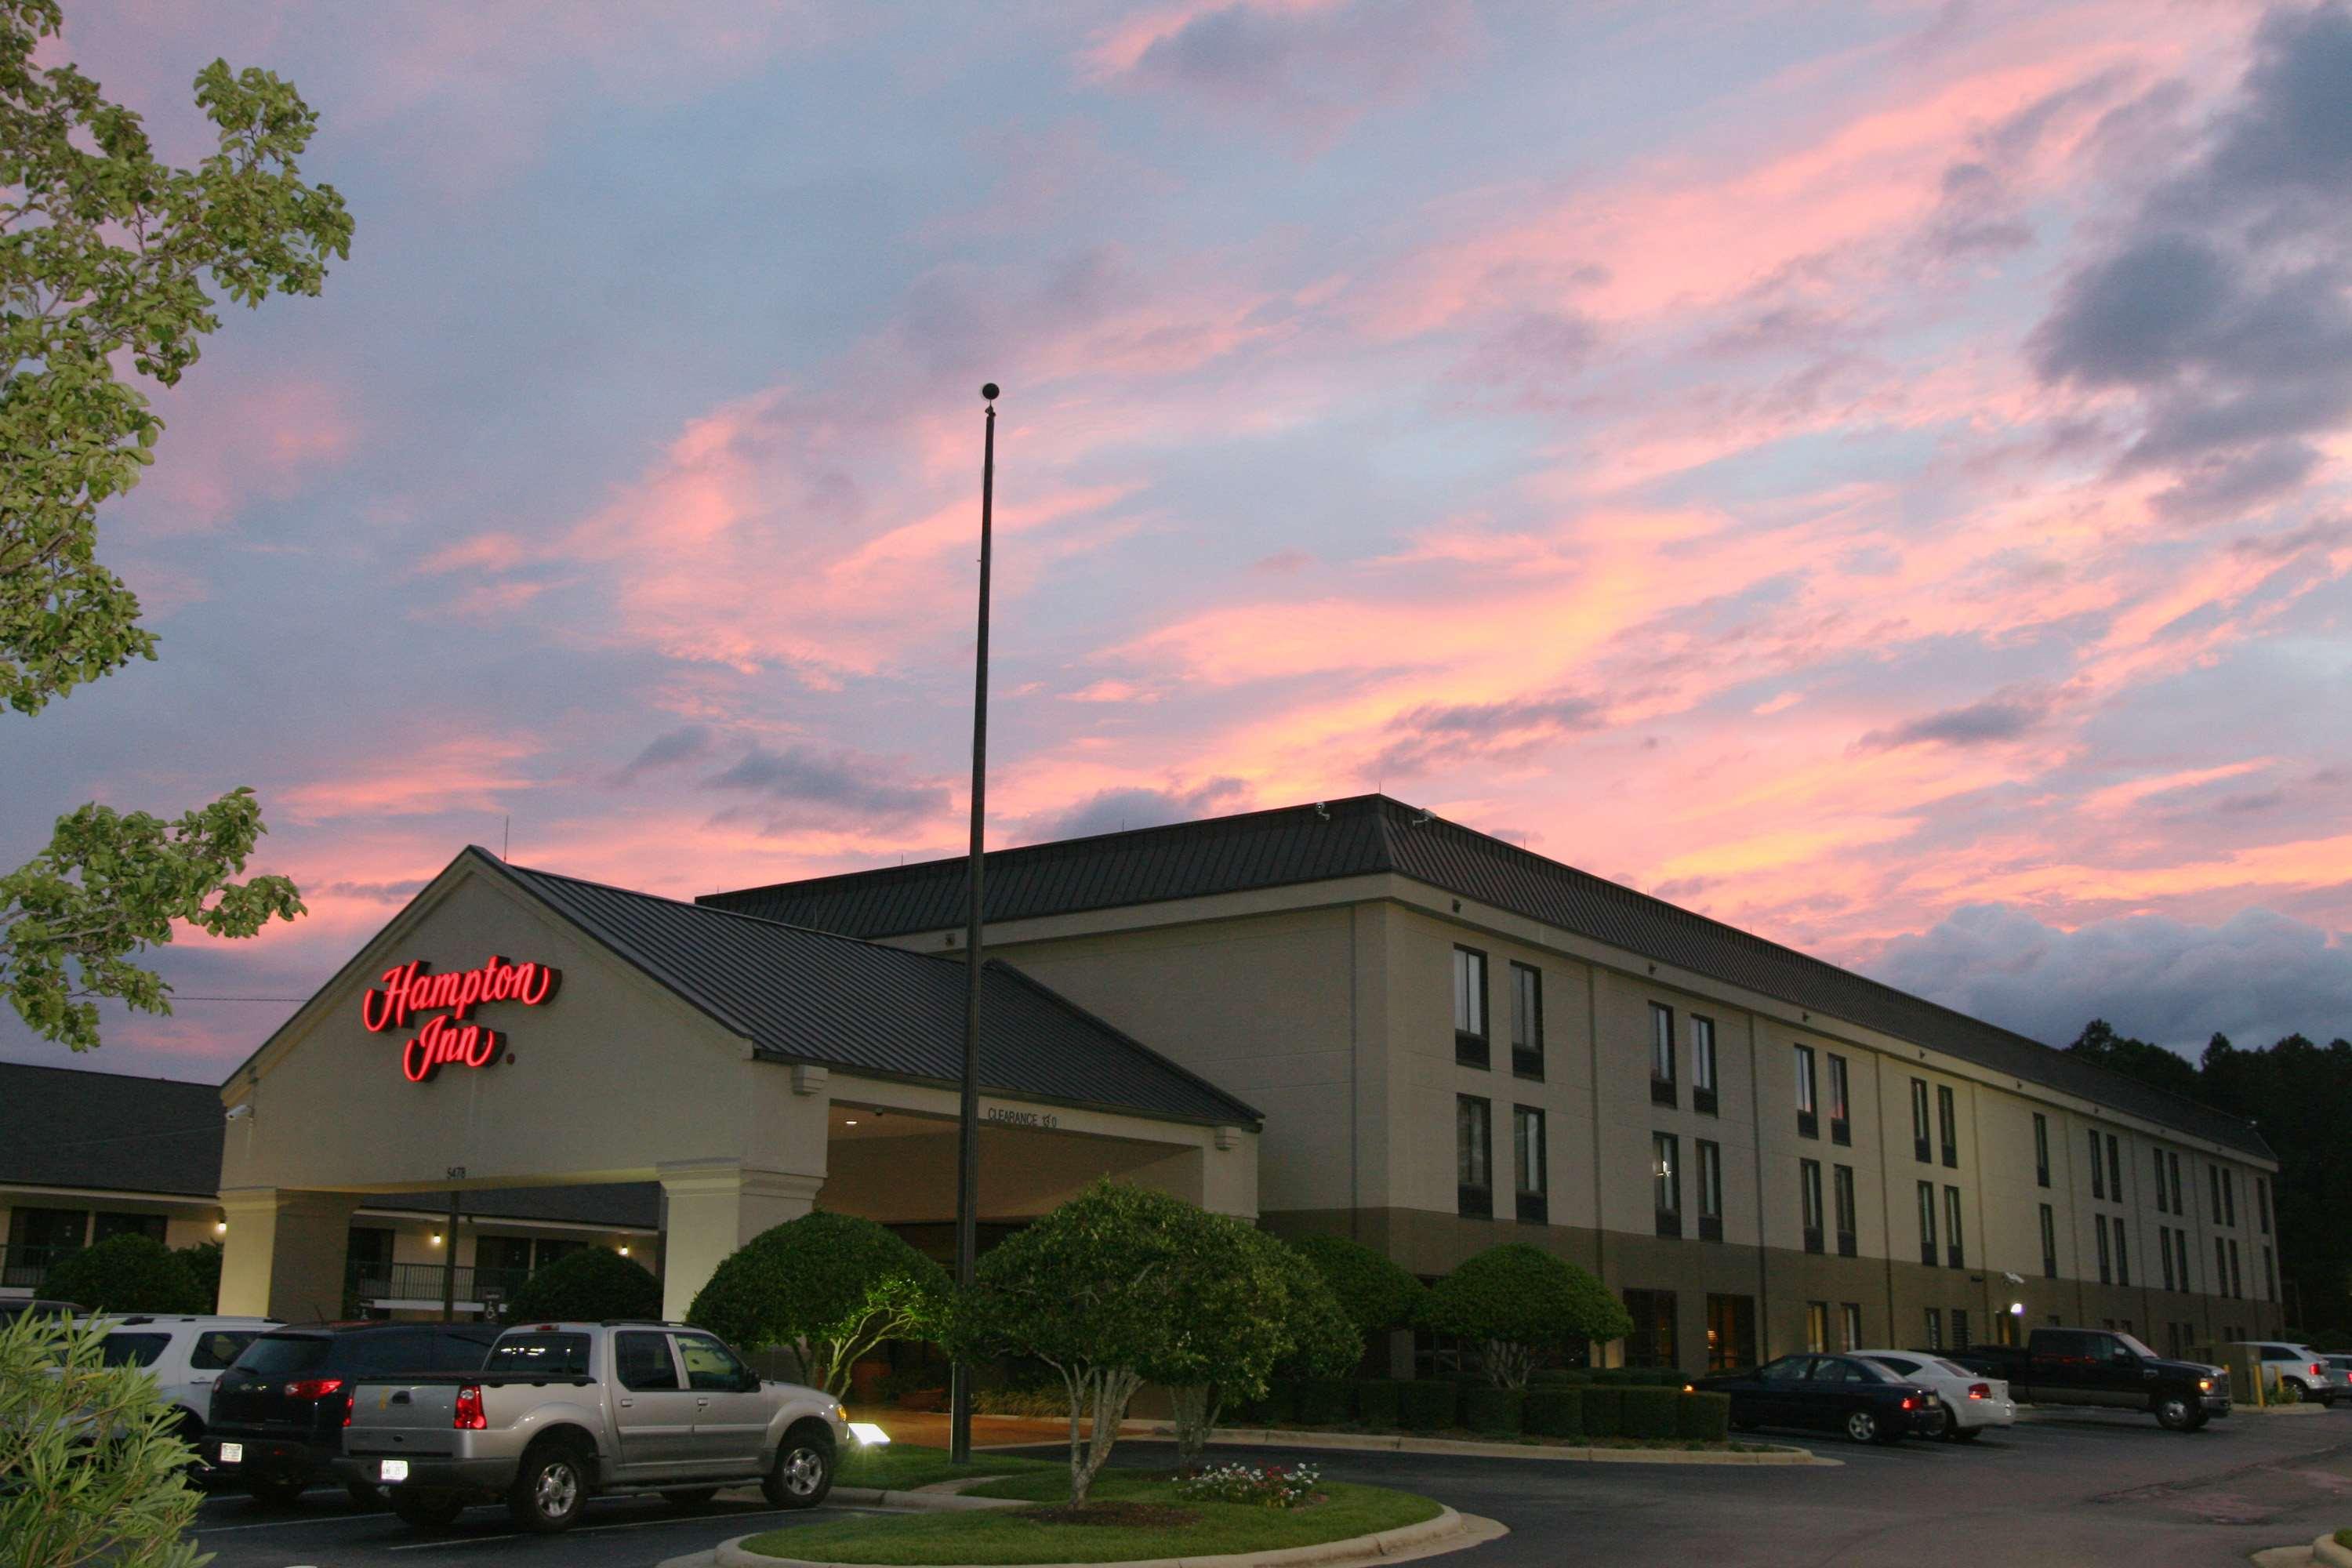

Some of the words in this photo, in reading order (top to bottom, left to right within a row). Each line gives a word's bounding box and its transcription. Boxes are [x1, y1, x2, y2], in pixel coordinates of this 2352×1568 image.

[363, 954, 553, 1033] Hampton
[402, 1014, 496, 1083] Inn
[988, 1107, 1038, 1127] CLEARANCE
